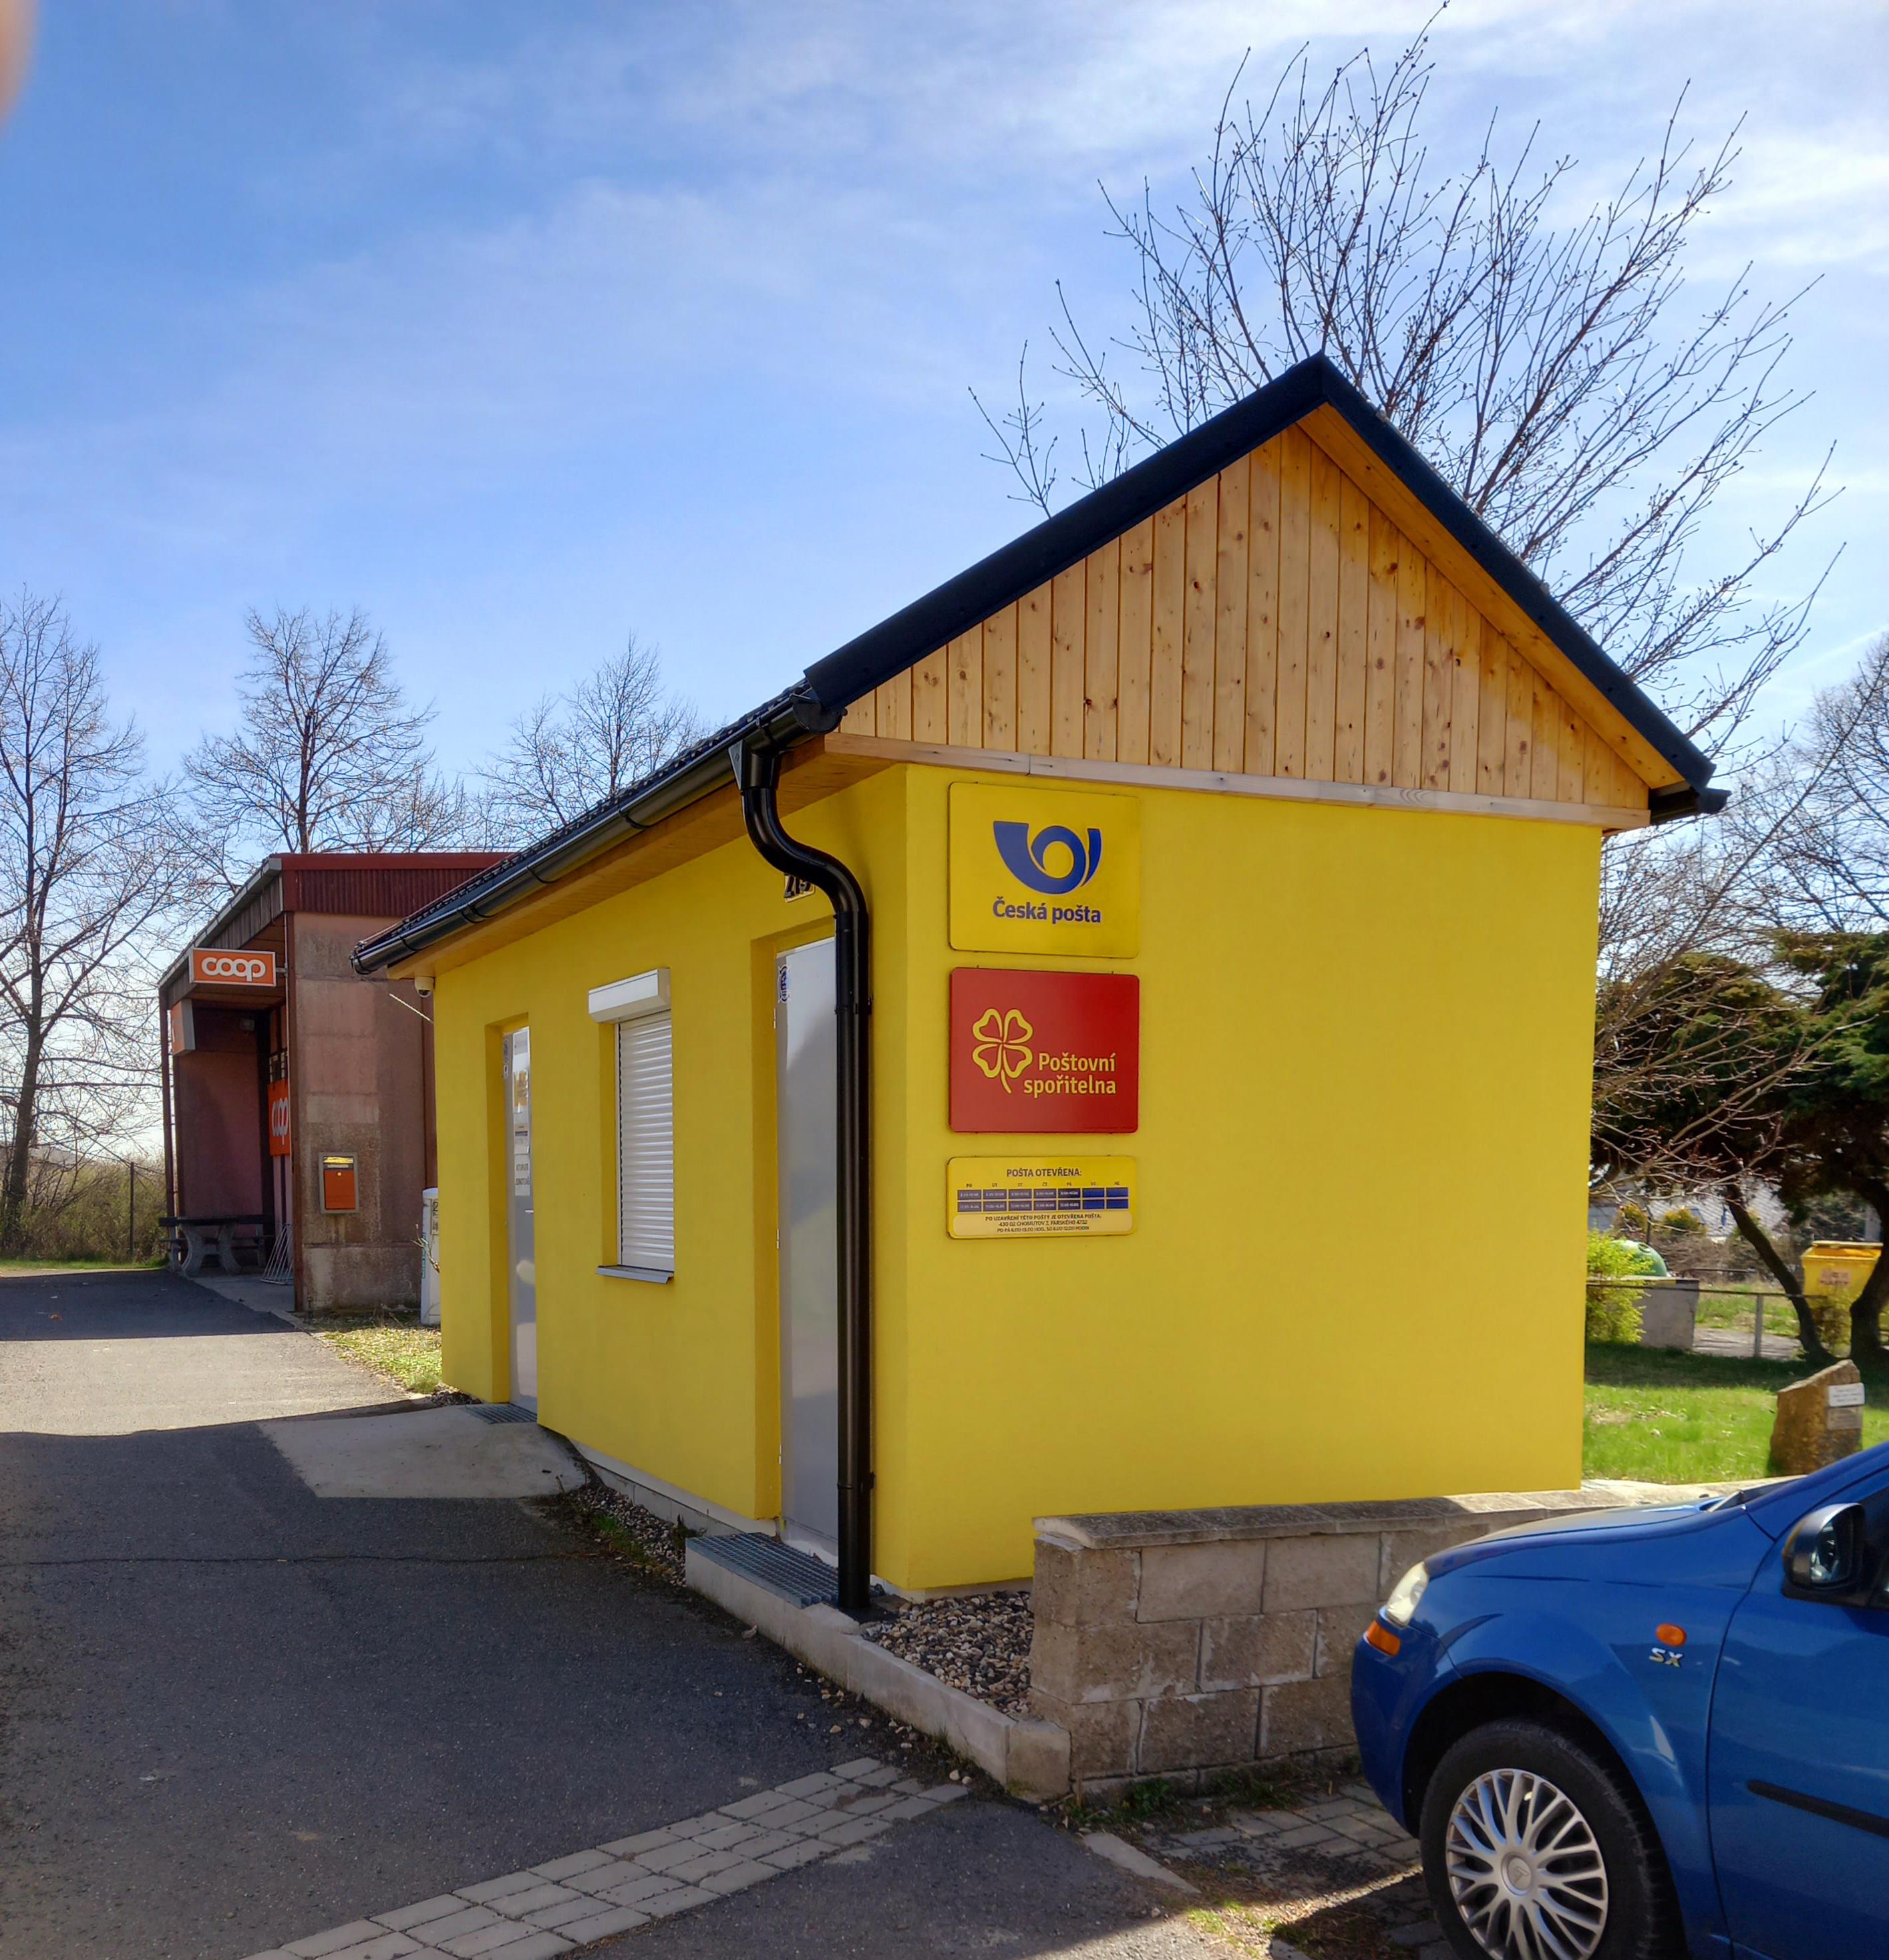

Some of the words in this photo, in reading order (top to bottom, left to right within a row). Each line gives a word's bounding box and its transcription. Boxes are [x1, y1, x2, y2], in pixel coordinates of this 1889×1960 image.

[993, 896, 1047, 920] Česká
[1052, 905, 1101, 924] pošta
[202, 957, 266, 982] coop
[1039, 1051, 1116, 1072] Poštovní
[1023, 1074, 1116, 1099] spořitelna
[1007, 1168, 1034, 1177] POŠTA
[1035, 1167, 1082, 1176] OTEVŘENA:
[1649, 1647, 1683, 1668] SX
